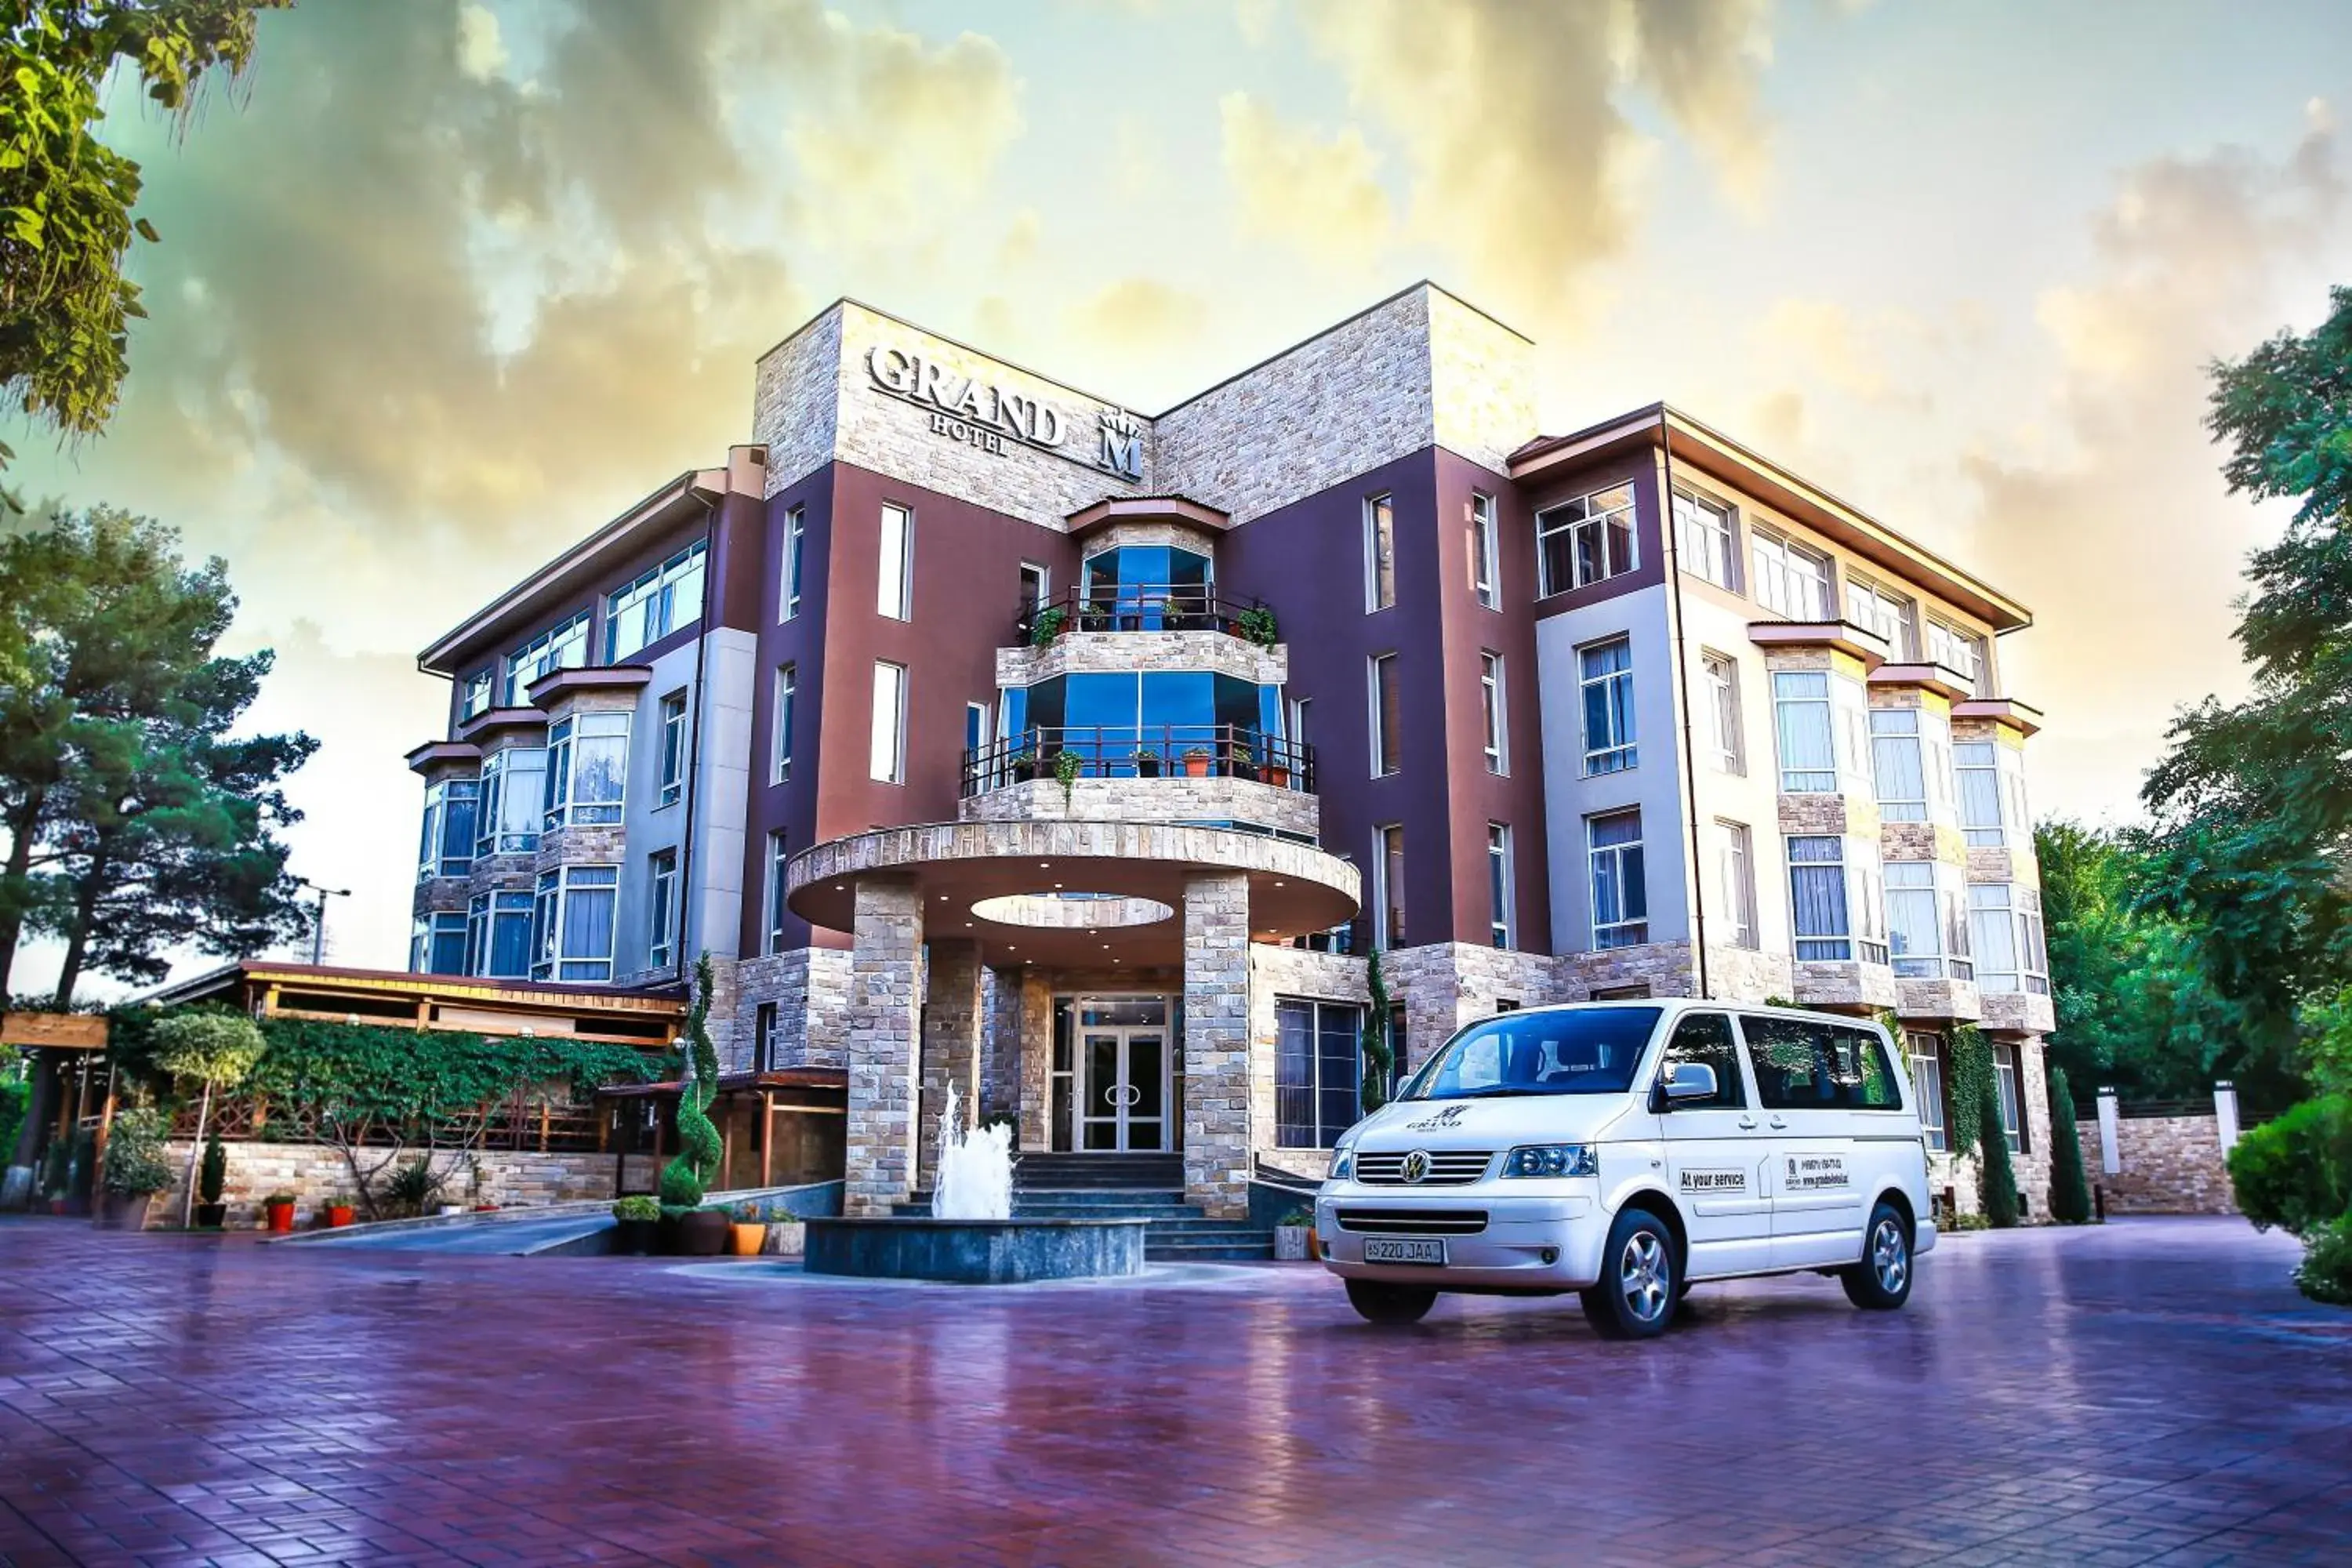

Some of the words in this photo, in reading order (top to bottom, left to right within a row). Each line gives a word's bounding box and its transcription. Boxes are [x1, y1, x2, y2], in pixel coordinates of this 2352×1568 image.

[867, 343, 1067, 448] GRAND
[931, 413, 1011, 457] HOTEL
[1681, 1171, 1691, 1186] At
[1693, 1174, 1713, 1192] your
[1715, 1174, 1744, 1186] service
[1381, 1242, 1402, 1258] 220
[1407, 1243, 1432, 1259] JAA
